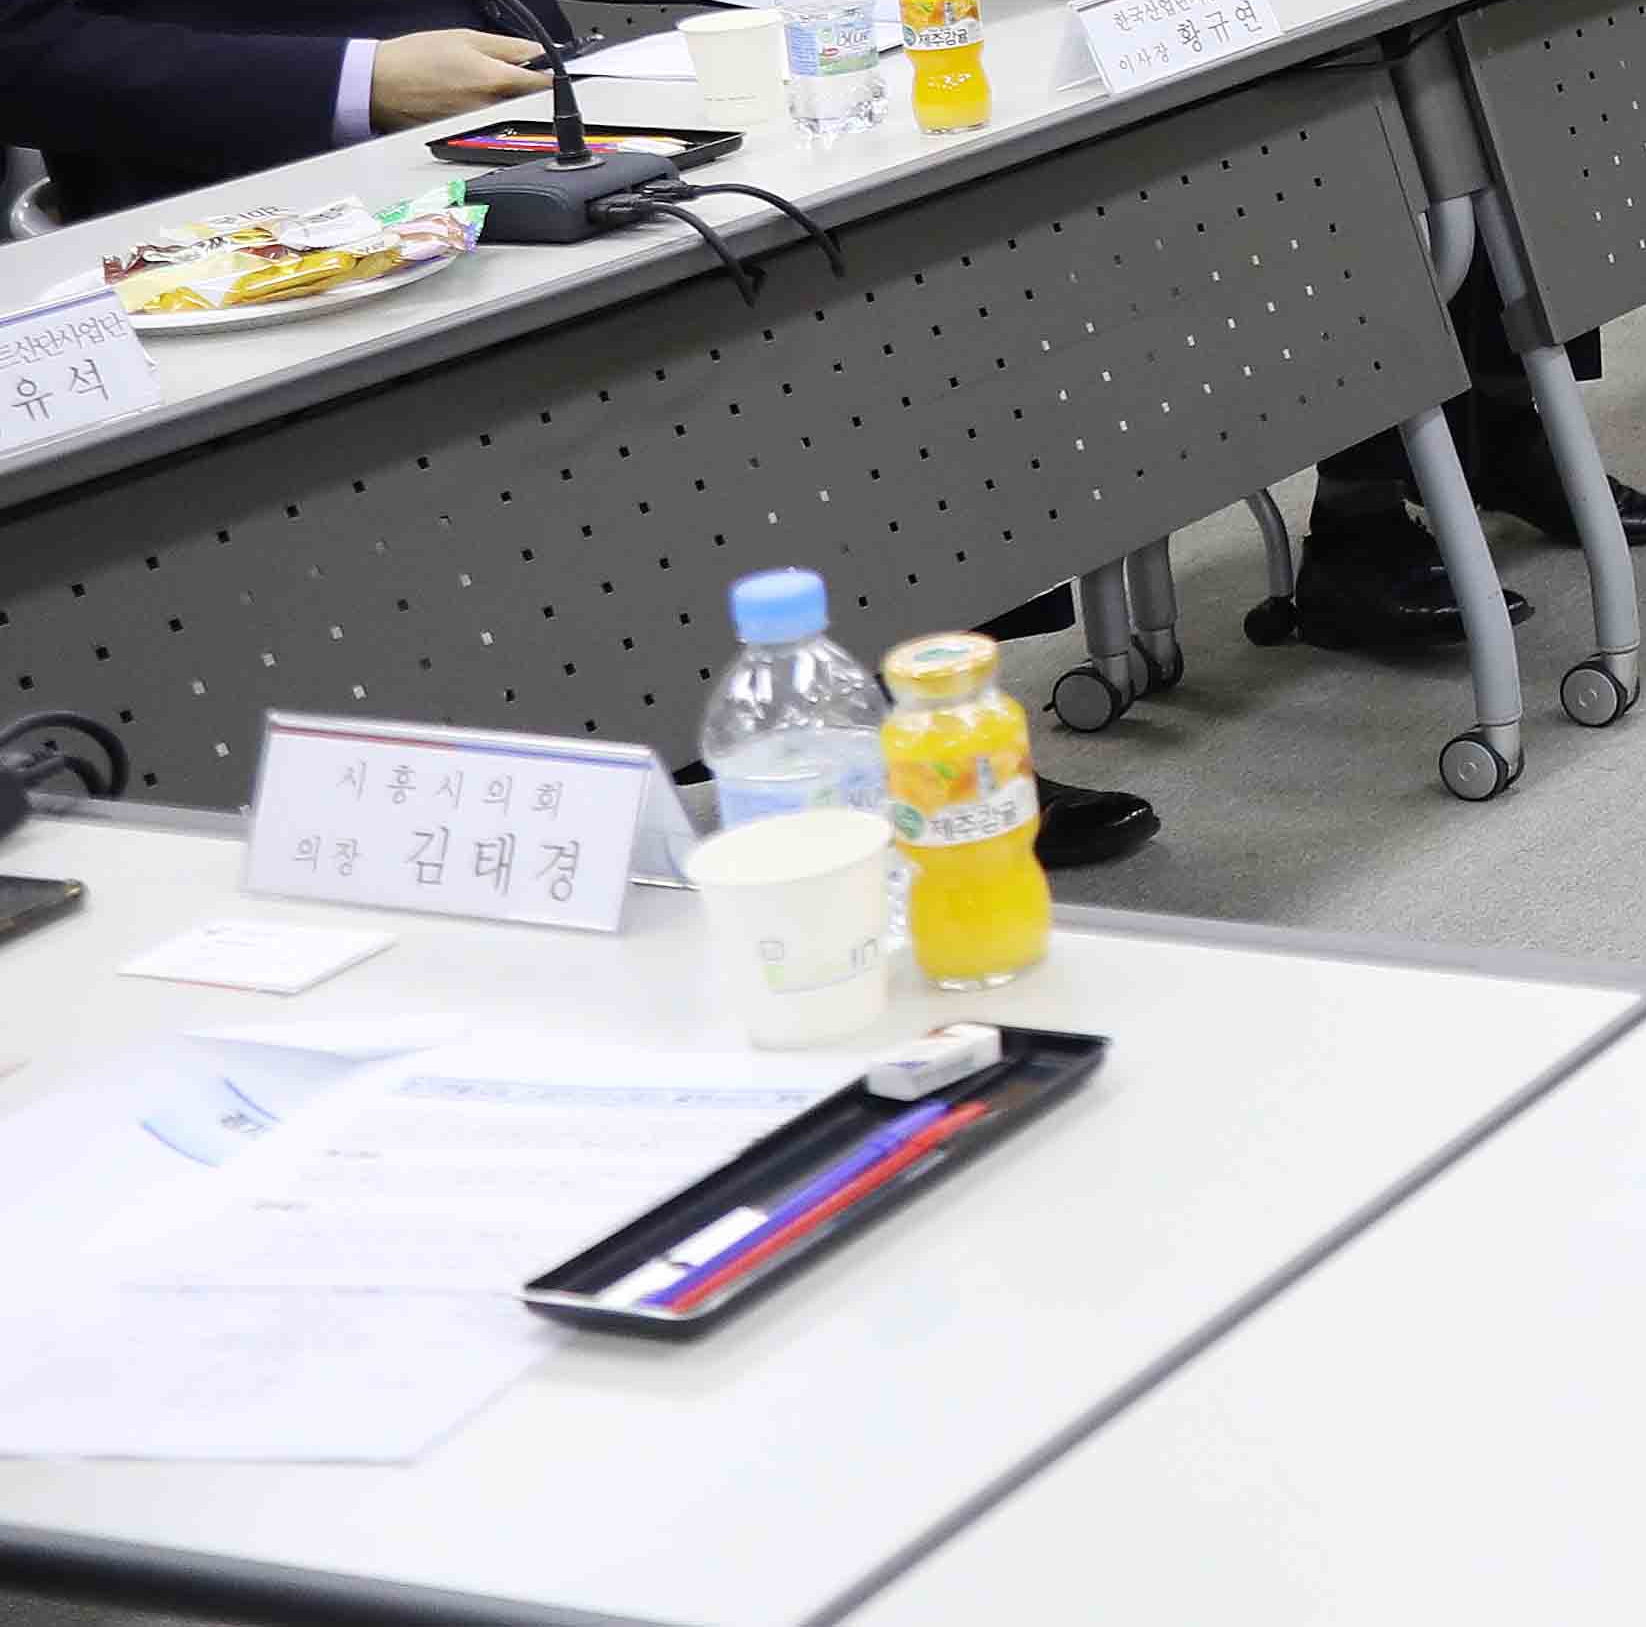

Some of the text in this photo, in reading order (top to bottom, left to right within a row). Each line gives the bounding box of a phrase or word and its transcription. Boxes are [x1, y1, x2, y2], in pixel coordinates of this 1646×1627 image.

[1119, 0, 1263, 74] 이사장 황규연
[336, 760, 564, 820] 시흥시의회
[293, 826, 581, 903] 의장 김태경
